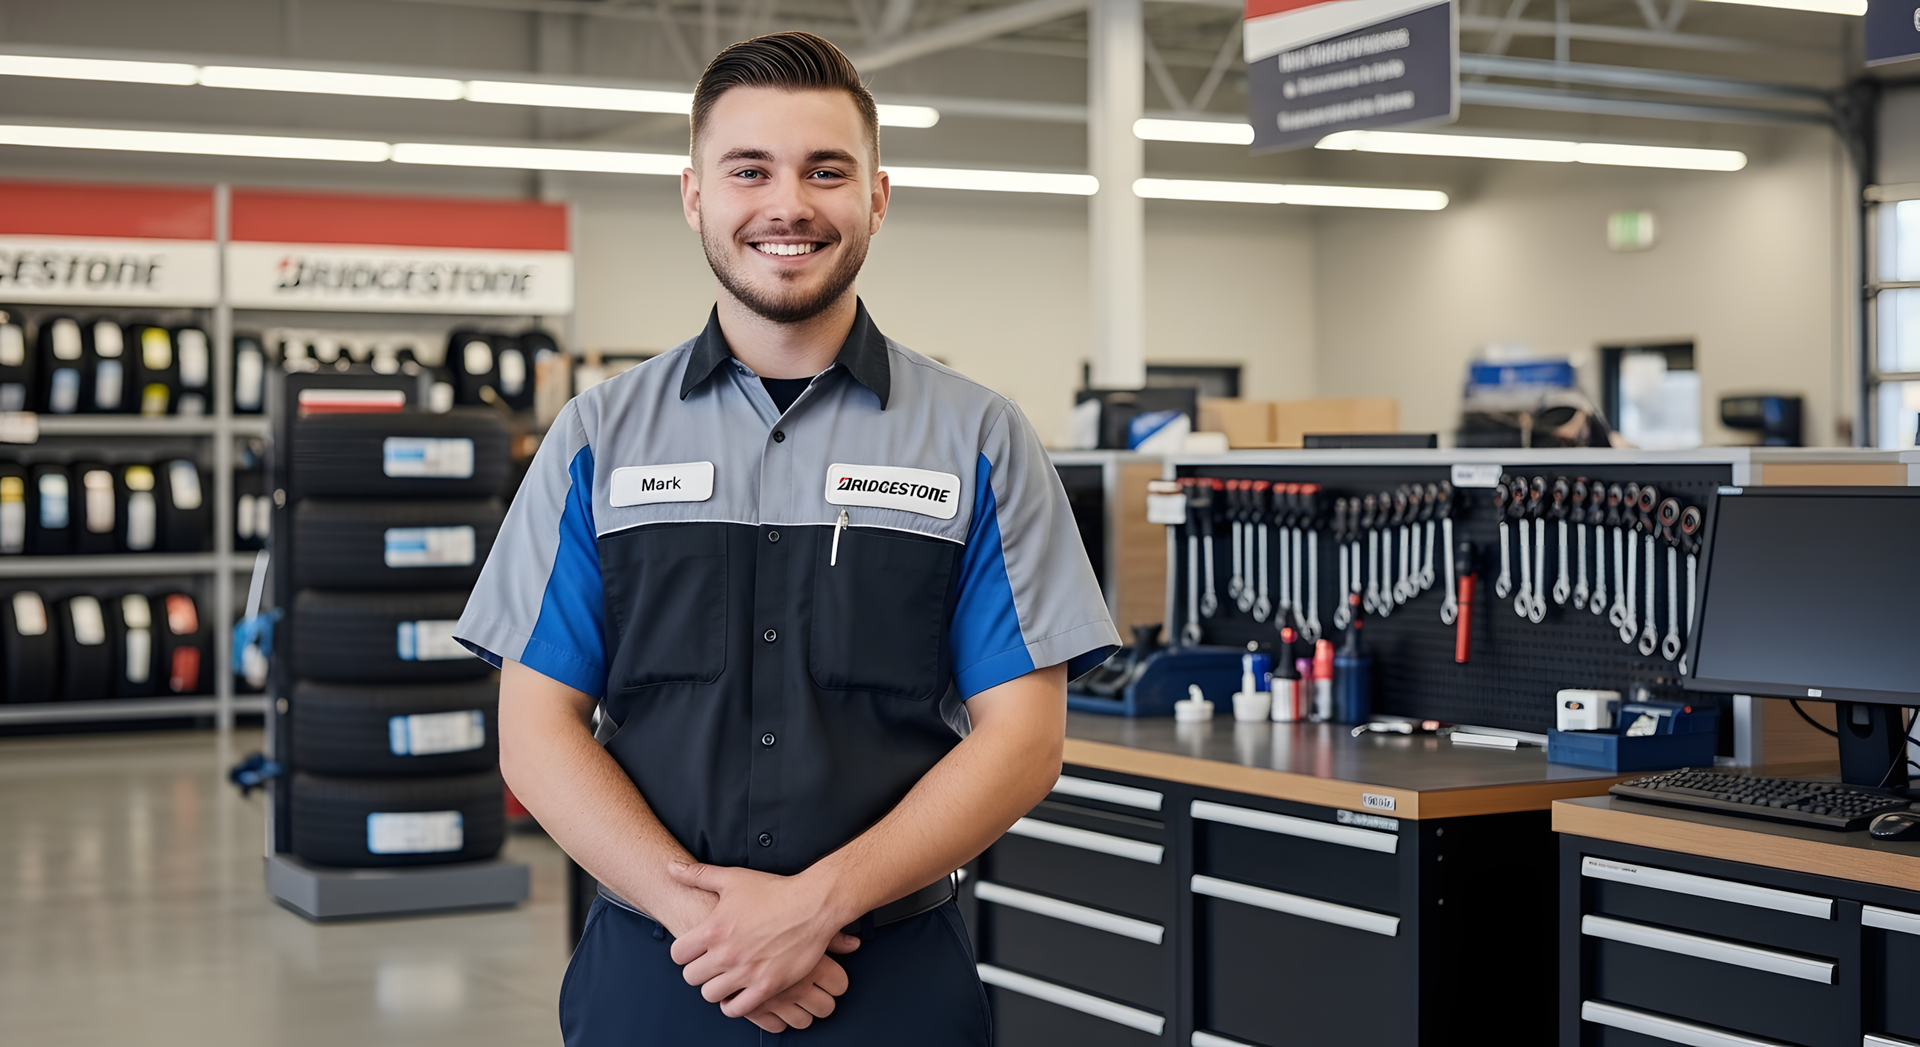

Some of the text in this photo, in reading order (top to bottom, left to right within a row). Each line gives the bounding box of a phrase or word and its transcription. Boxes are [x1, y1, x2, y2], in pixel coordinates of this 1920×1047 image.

[276, 255, 534, 299] BRIDGESTONE
[641, 475, 682, 492] Mark
[837, 476, 951, 503] BRIDGESTONE
